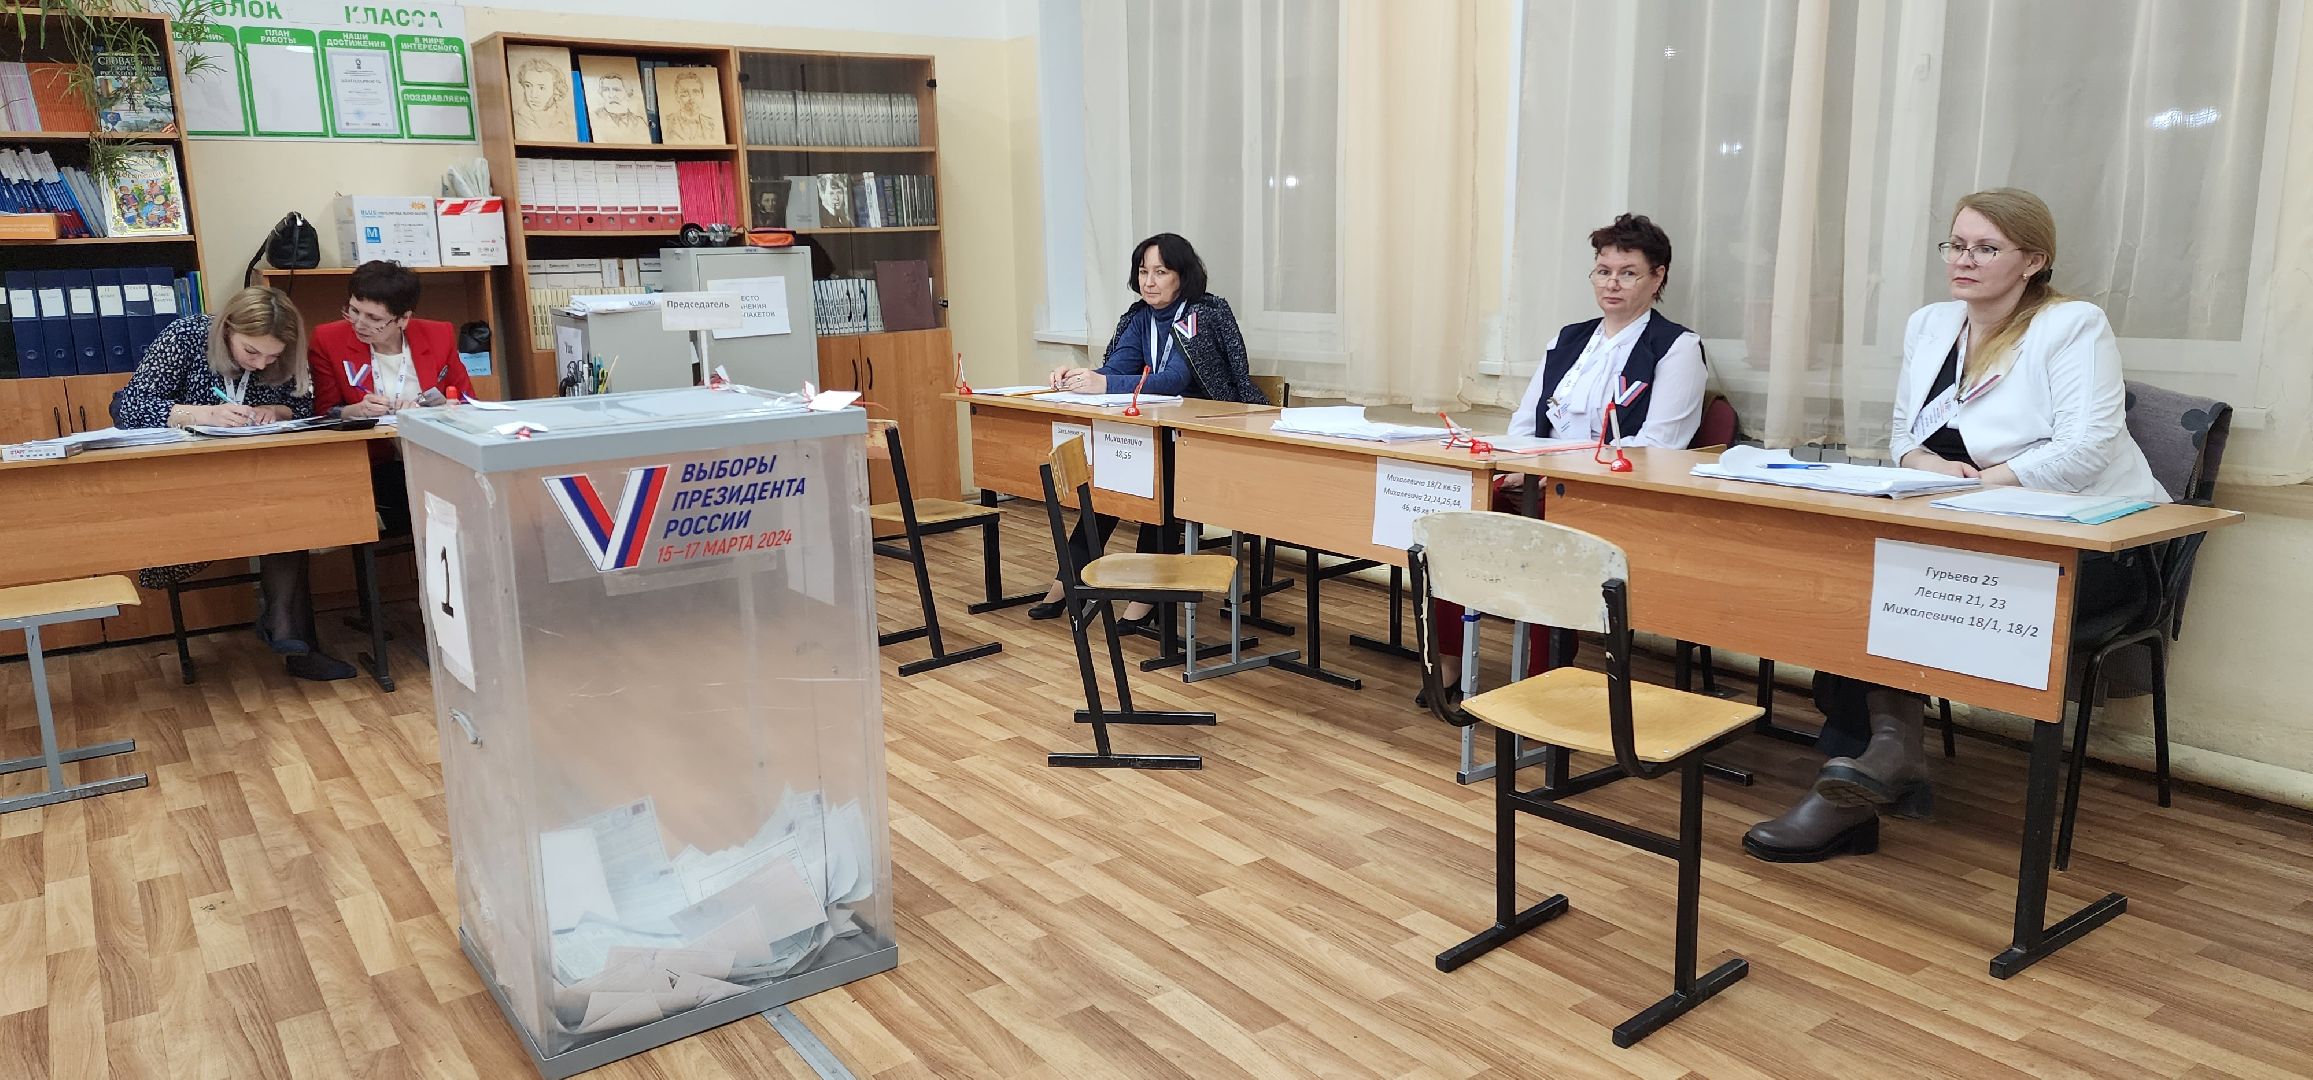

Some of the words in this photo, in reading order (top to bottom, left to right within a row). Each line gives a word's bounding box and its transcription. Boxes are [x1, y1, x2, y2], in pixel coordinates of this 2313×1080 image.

[260, 36, 297, 44] РАБОТЫ
[265, 29, 290, 37] ПЛАН
[342, 32, 369, 41] НАШИ
[326, 38, 386, 48] ДОСТИЖЕНИЯ
[401, 42, 459, 52] ИНТЕРЕСНОГО
[403, 93, 469, 103] ПОЗДРАВЛЯЕМ!
[666, 300, 730, 310] Председатель
[680, 455, 778, 483] ВЫБОРЫ
[1426, 480, 1442, 490] 18/2
[671, 477, 806, 511] ПРЕЗИДЕНТА
[662, 510, 752, 539] РОССИИ
[703, 534, 753, 558] МАРТА
[757, 529, 793, 550] 2024
[441, 546, 455, 618] 1
[1925, 566, 1978, 584] Гурьева
[1981, 574, 1999, 587] 25
[1914, 586, 1962, 604] Лесная
[1965, 594, 1985, 609] 21,
[1989, 597, 2006, 610] 23
[1882, 602, 1965, 625] Михалевича
[1967, 616, 2002, 633] 18/1,
[2006, 622, 2039, 638] 18/2
